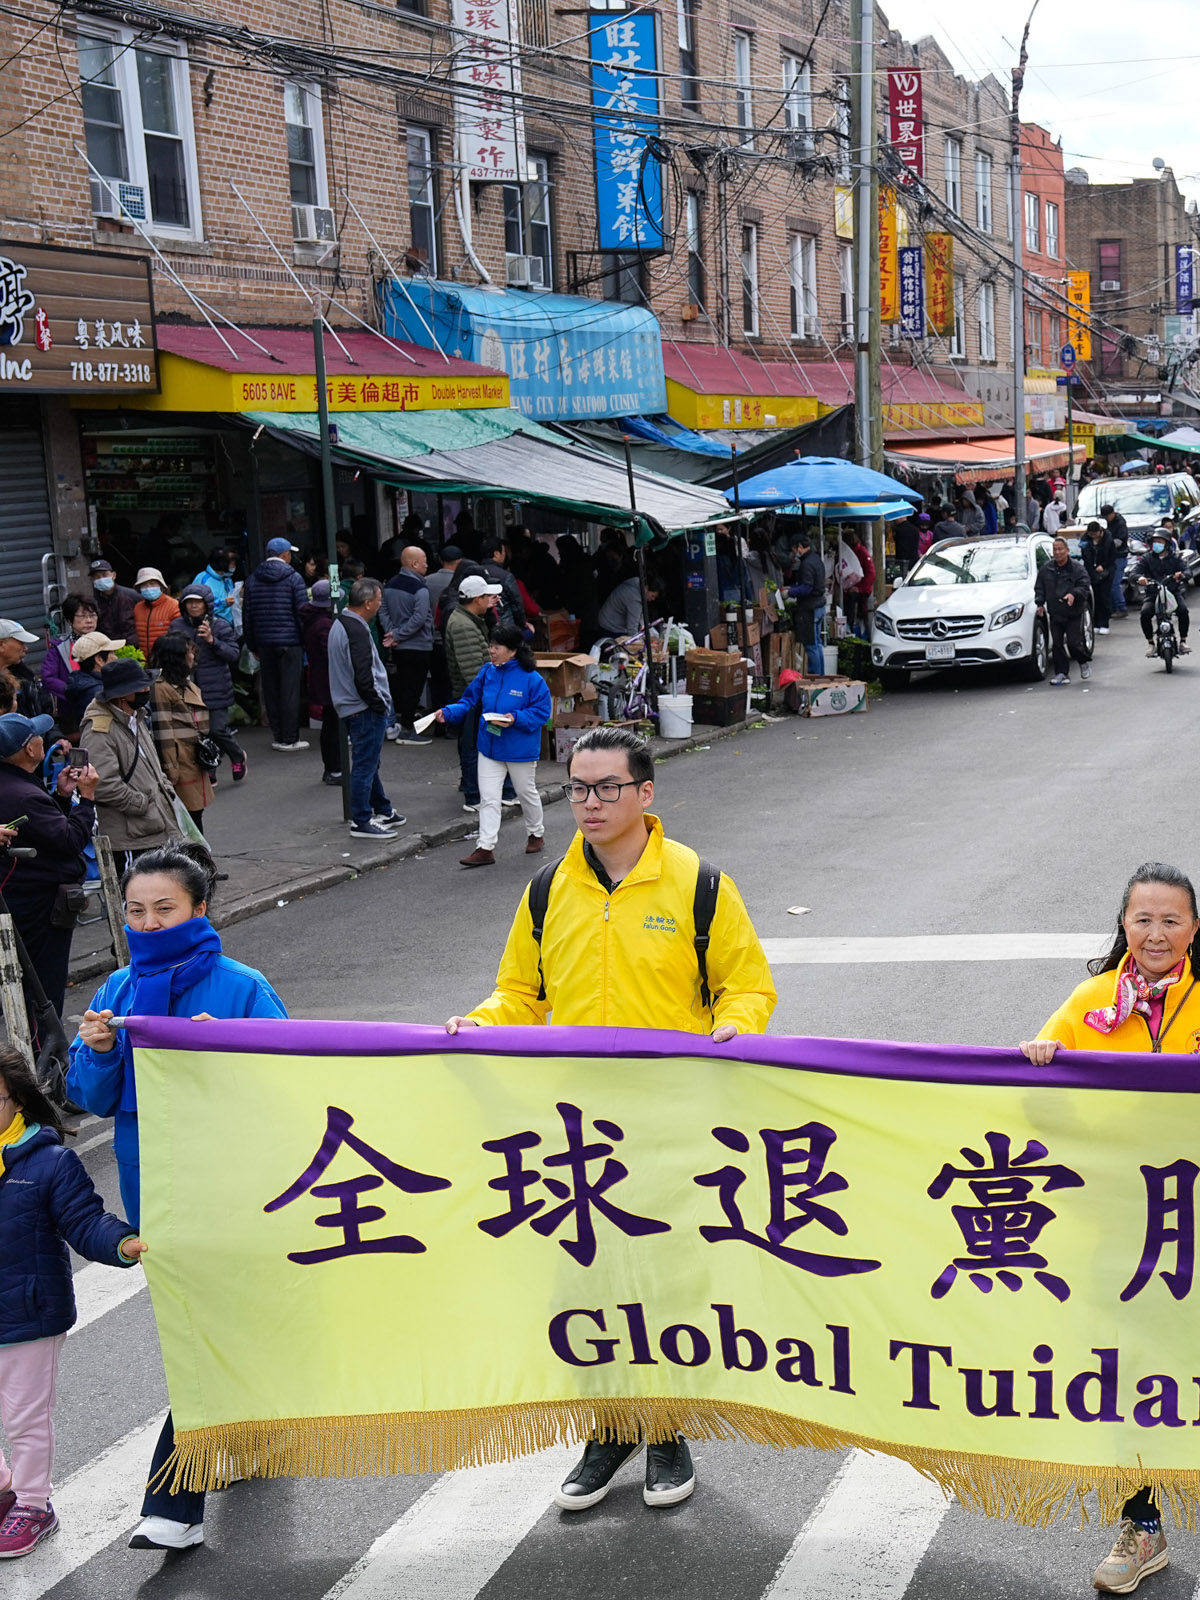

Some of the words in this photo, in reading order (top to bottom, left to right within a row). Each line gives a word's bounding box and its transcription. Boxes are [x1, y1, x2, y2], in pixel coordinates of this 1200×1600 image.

[471, 168, 514, 178] 437-7717
[75, 318, 146, 350] 粤菜风味
[70, 361, 151, 383] 718-877-3318
[242, 383, 268, 401] 5605
[270, 383, 296, 400] 8AVE
[432, 384, 455, 401] Double
[457, 383, 481, 400] Harvest
[482, 382, 503, 400] Market
[511, 396, 533, 415] ANG
[572, 396, 607, 414] SEAFOOD
[609, 393, 640, 411] CUISINE
[691, 544, 700, 559] P
[548, 1303, 856, 1396] Global
